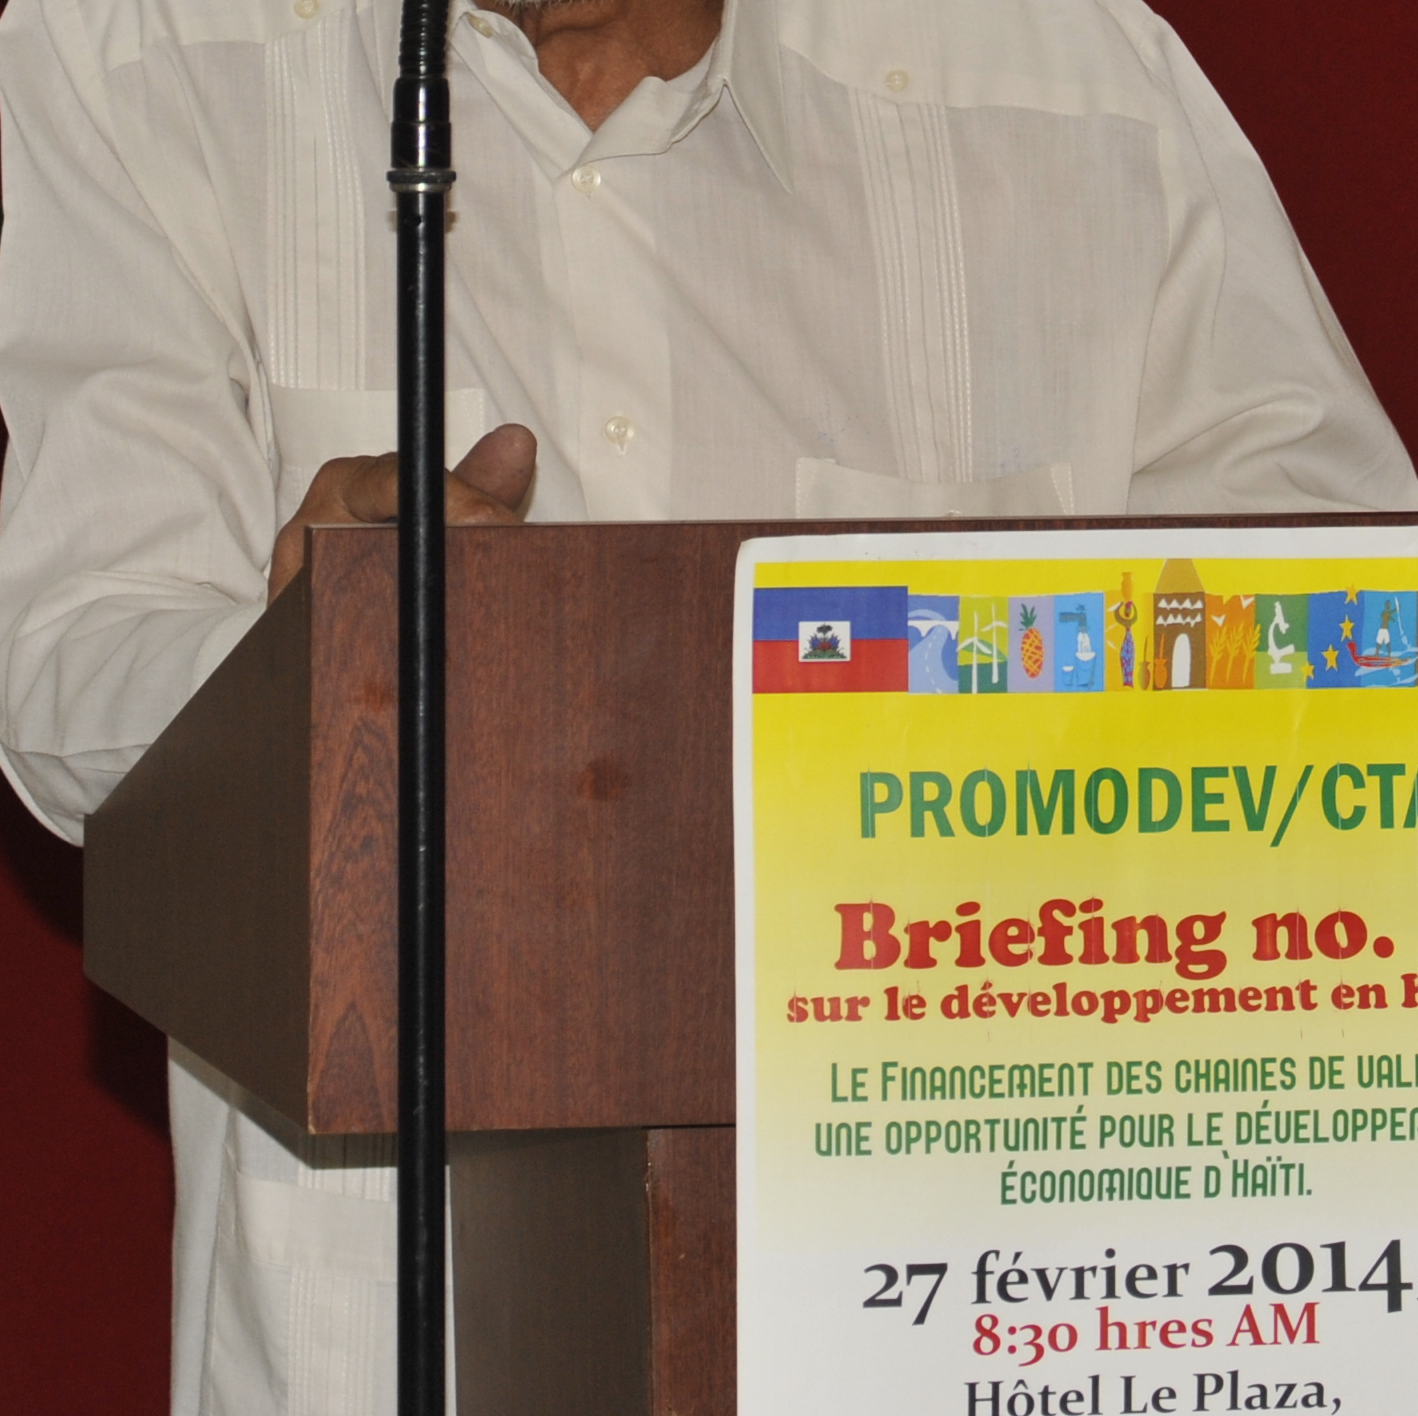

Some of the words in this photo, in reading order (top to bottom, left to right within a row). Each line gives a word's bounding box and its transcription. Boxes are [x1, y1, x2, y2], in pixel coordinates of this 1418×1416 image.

[834, 897, 1228, 981] Briefing
[1252, 909, 1395, 963] no.
[786, 993, 871, 1024] sur
[883, 985, 927, 1021] le
[939, 977, 1319, 1025] développement
[1330, 980, 1389, 1012] en
[862, 1260, 949, 1327] 27
[970, 1248, 1191, 1307] février
[972, 1312, 1079, 1368] 8:30
[1095, 1305, 1215, 1352] hres
[1225, 1301, 1321, 1348] AM
[963, 1374, 1104, 1416] Hôtel
[1119, 1375, 1179, 1415] Le
[1192, 1369, 1343, 1416] Plaza,
